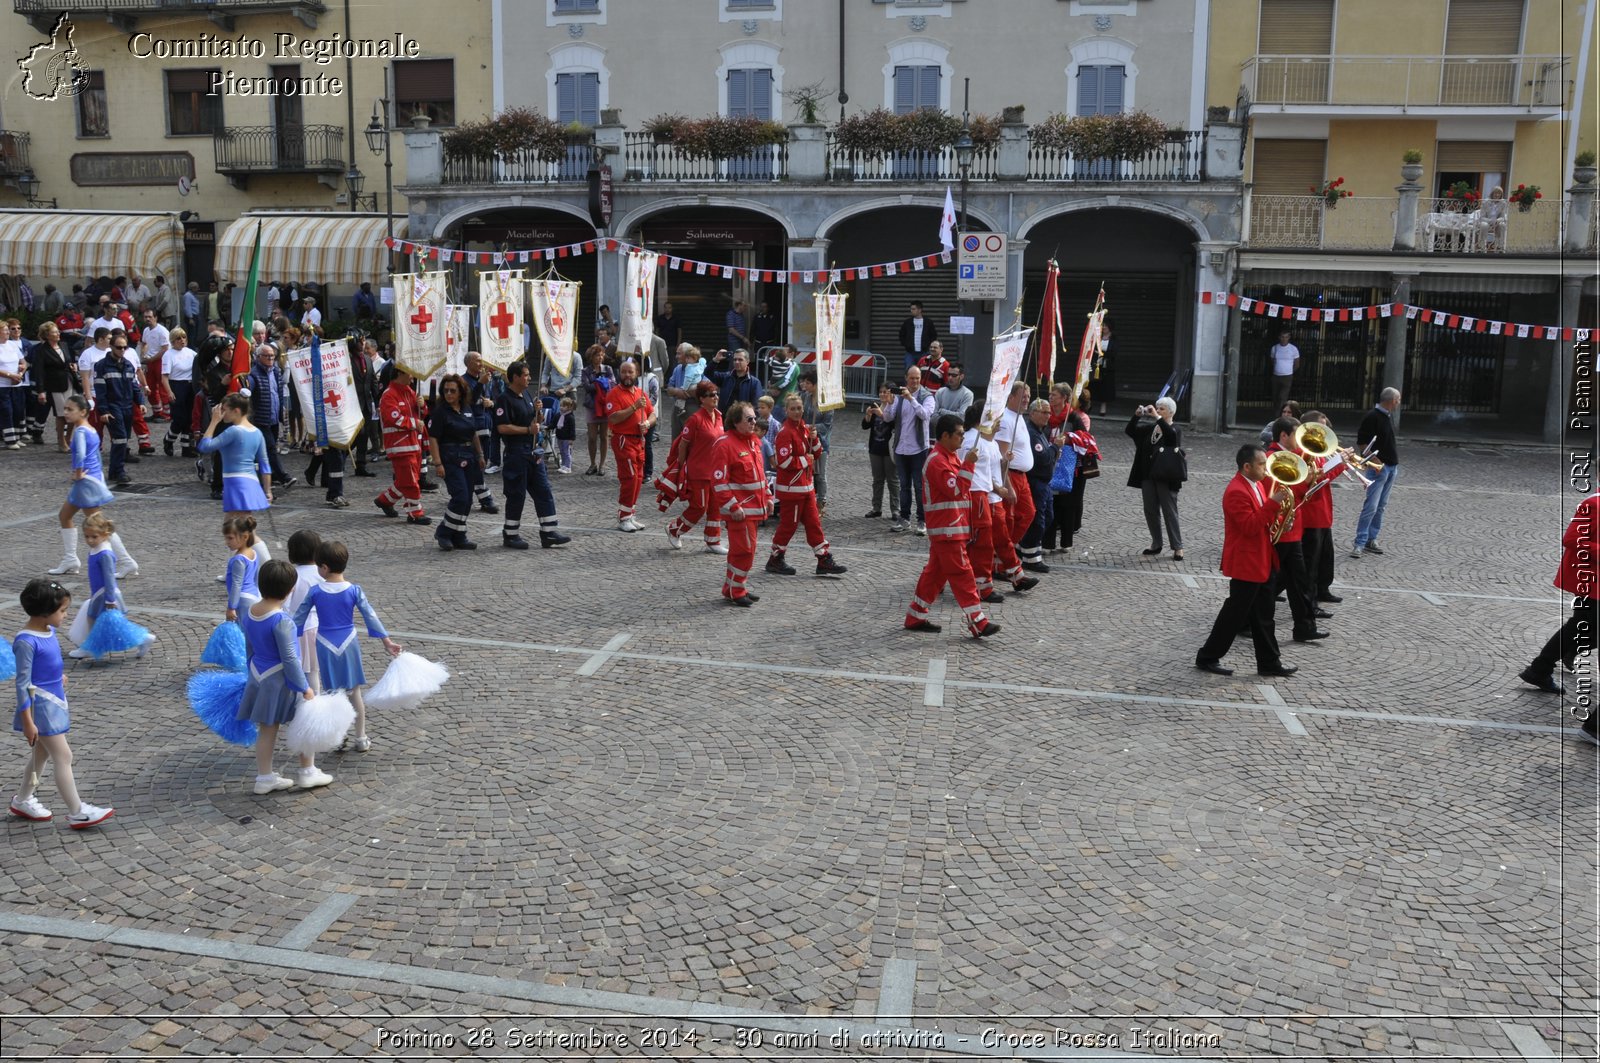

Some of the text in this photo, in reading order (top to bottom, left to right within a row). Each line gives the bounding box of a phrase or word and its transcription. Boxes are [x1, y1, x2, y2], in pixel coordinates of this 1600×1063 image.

[506, 229, 555, 239] Macelleria
[685, 230, 735, 239] Salumeria
[962, 266, 971, 277] P
[295, 350, 345, 369] CRO ROSSA
